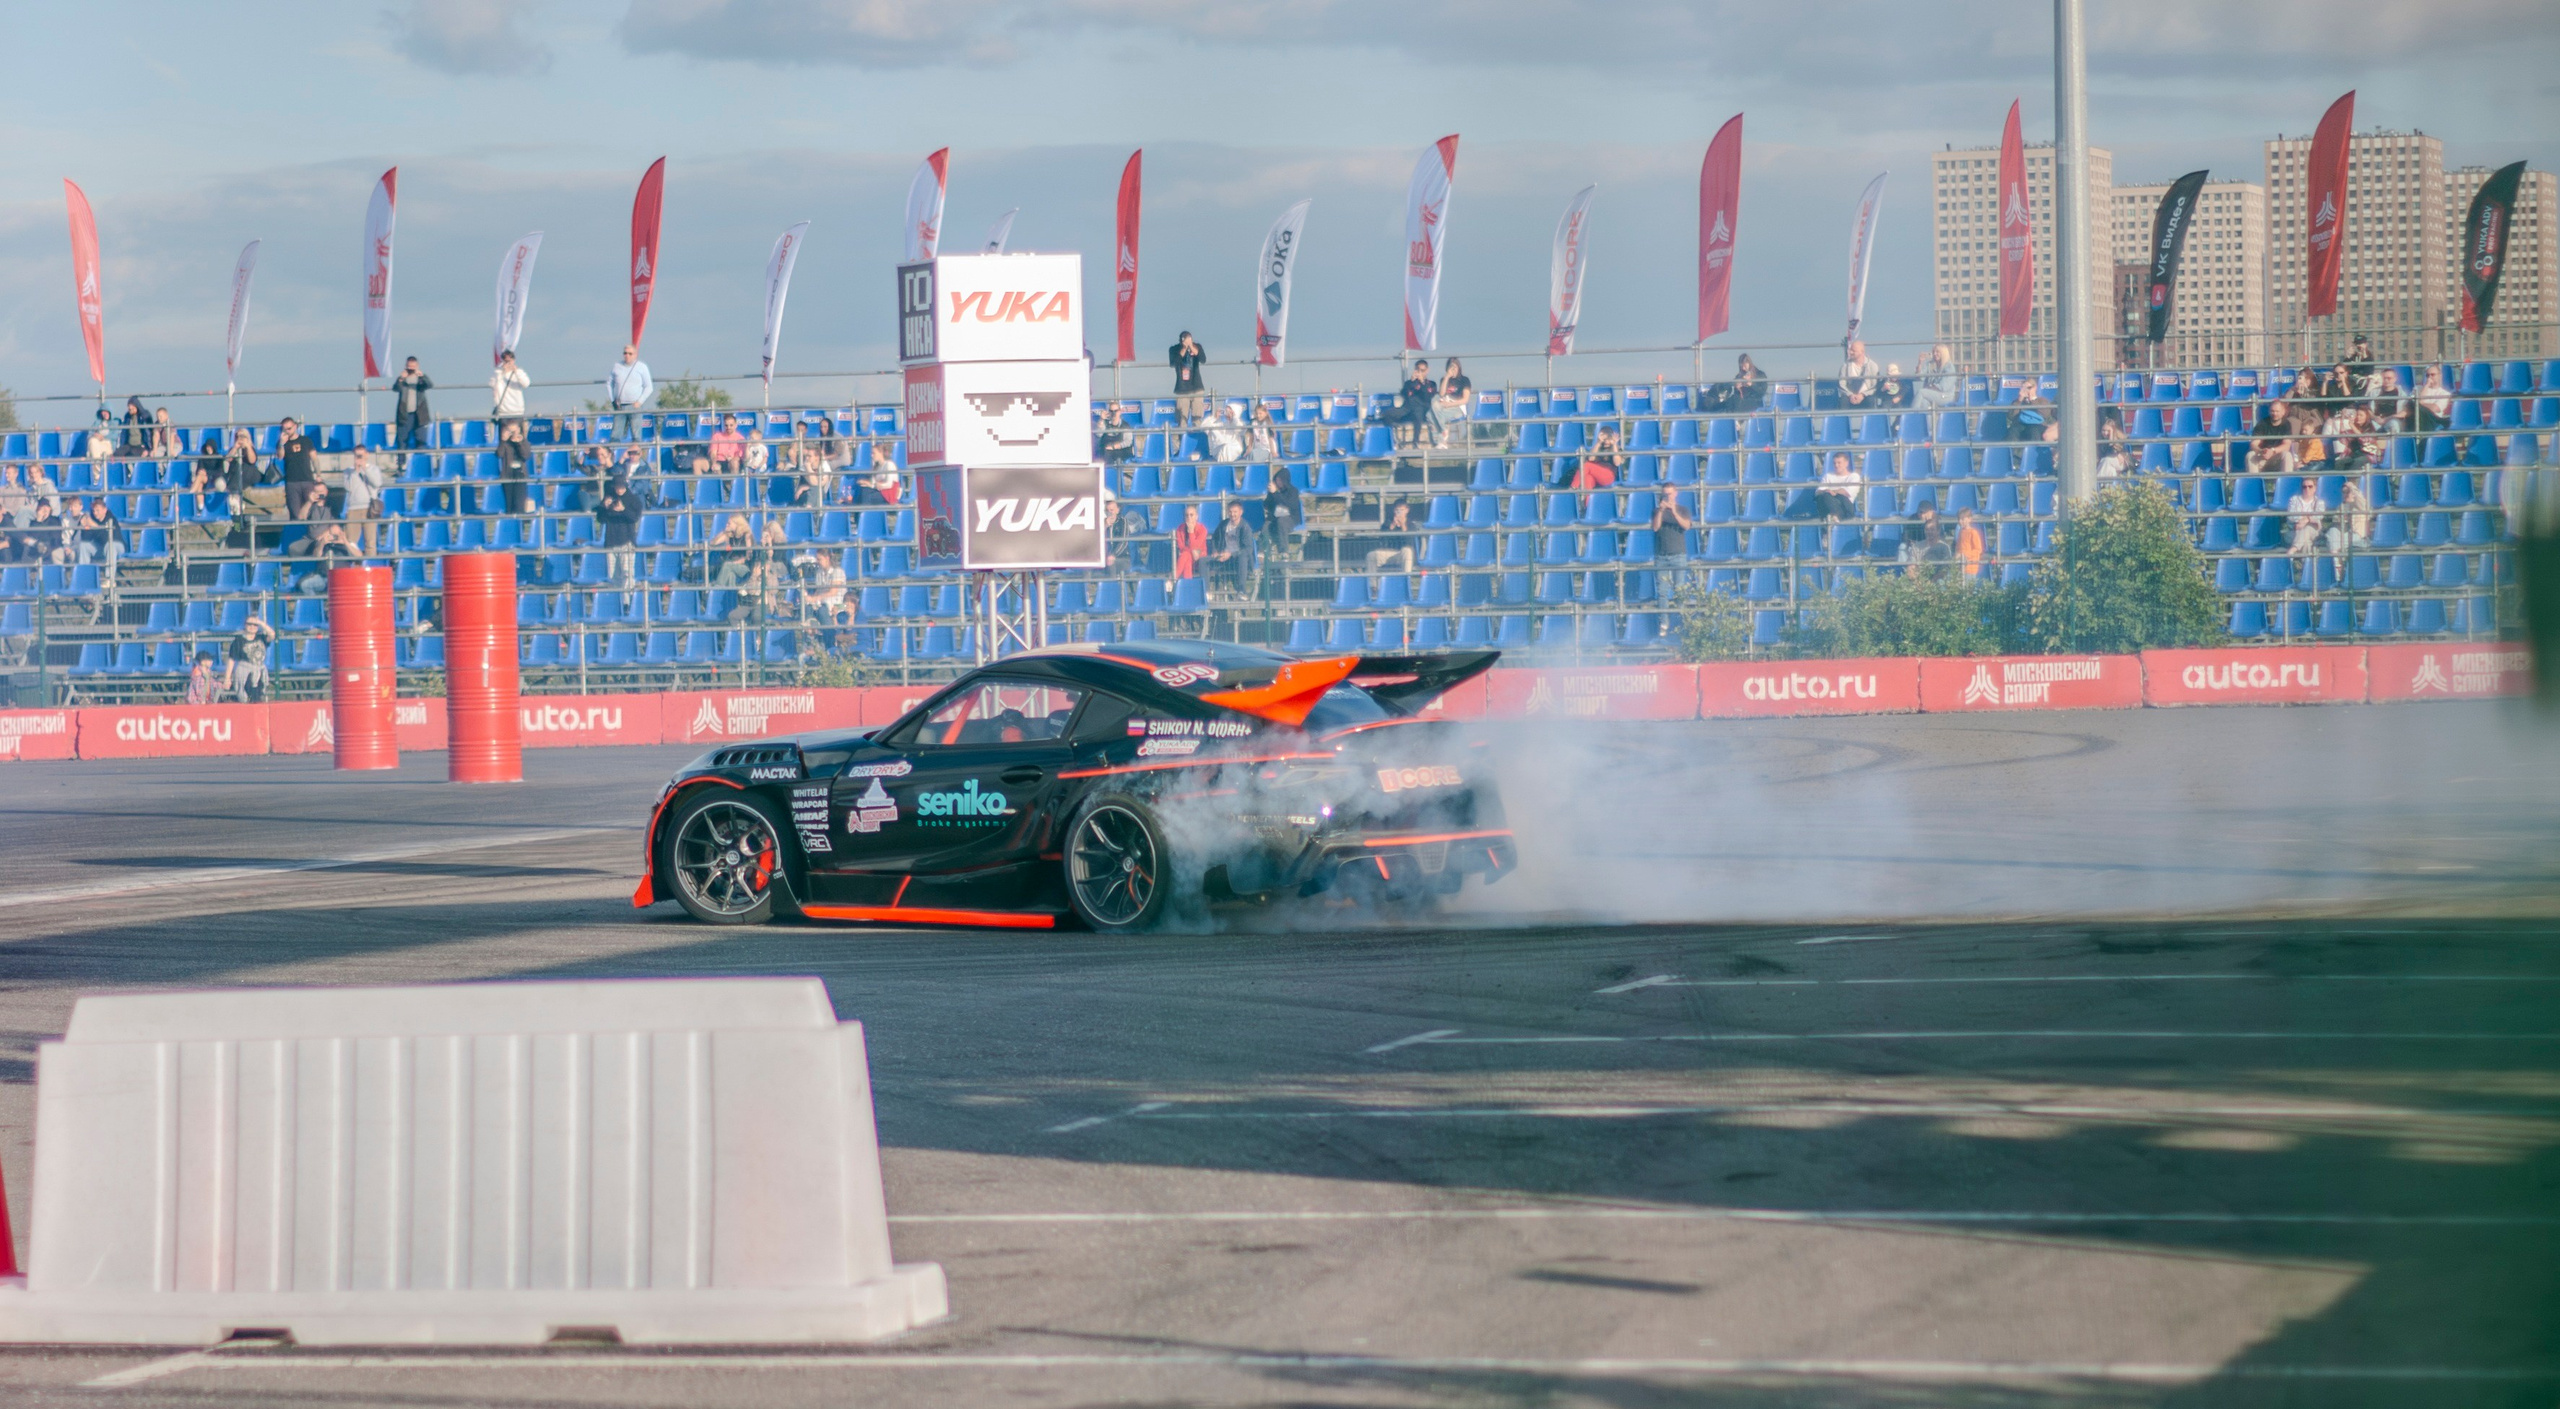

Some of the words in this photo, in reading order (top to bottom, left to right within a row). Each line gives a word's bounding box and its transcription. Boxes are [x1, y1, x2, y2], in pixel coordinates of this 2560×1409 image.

[905, 270, 932, 313] ГО
[950, 291, 1070, 323] YUKA
[905, 315, 933, 357] НКА
[908, 382, 943, 419] ДЖИМ
[908, 420, 943, 454] ХАНА
[975, 496, 1095, 533] YUKA
[1563, 671, 1658, 695] МОСКОВСКИЙ
[2003, 657, 2100, 683] МОСКОВСКИЙ
[2182, 662, 2320, 688] auto.ru
[1743, 673, 1877, 701] auto.ru
[2004, 682, 2050, 705] СПОРТ
[727, 692, 815, 715] МОСКОВСКИЙ
[116, 714, 231, 741] auto.ru
[521, 705, 622, 731] uto.ru
[727, 715, 769, 735] СПОРТ
[1148, 720, 1191, 736] SHIKOV
[791, 800, 828, 810] WRAPCAR
[793, 787, 828, 798] WHITELAB
[917, 779, 1007, 816] seniko
[957, 820, 1007, 828] systems
[803, 838, 826, 848] VRC
